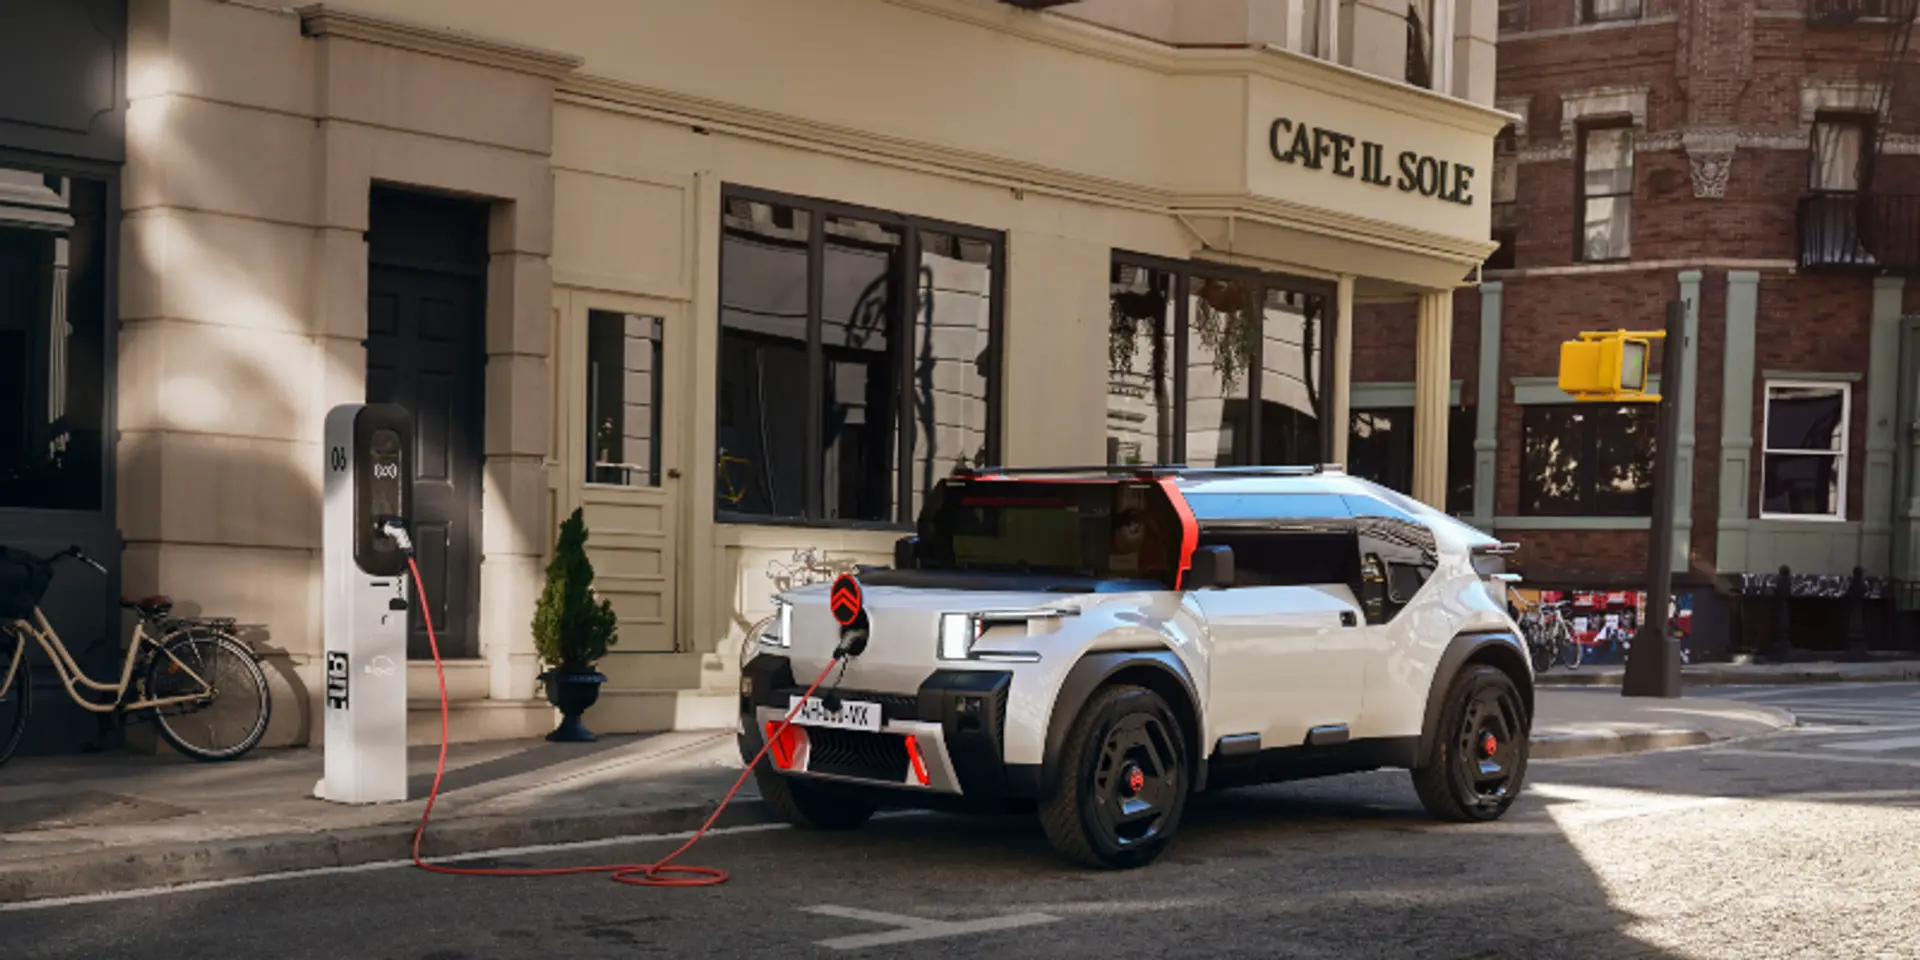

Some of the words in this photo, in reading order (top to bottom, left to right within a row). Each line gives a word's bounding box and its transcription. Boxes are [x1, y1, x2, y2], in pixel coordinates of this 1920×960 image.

[1269, 117, 1355, 178] CAFE
[1360, 141, 1391, 187] IL
[1397, 151, 1475, 205] SOLE
